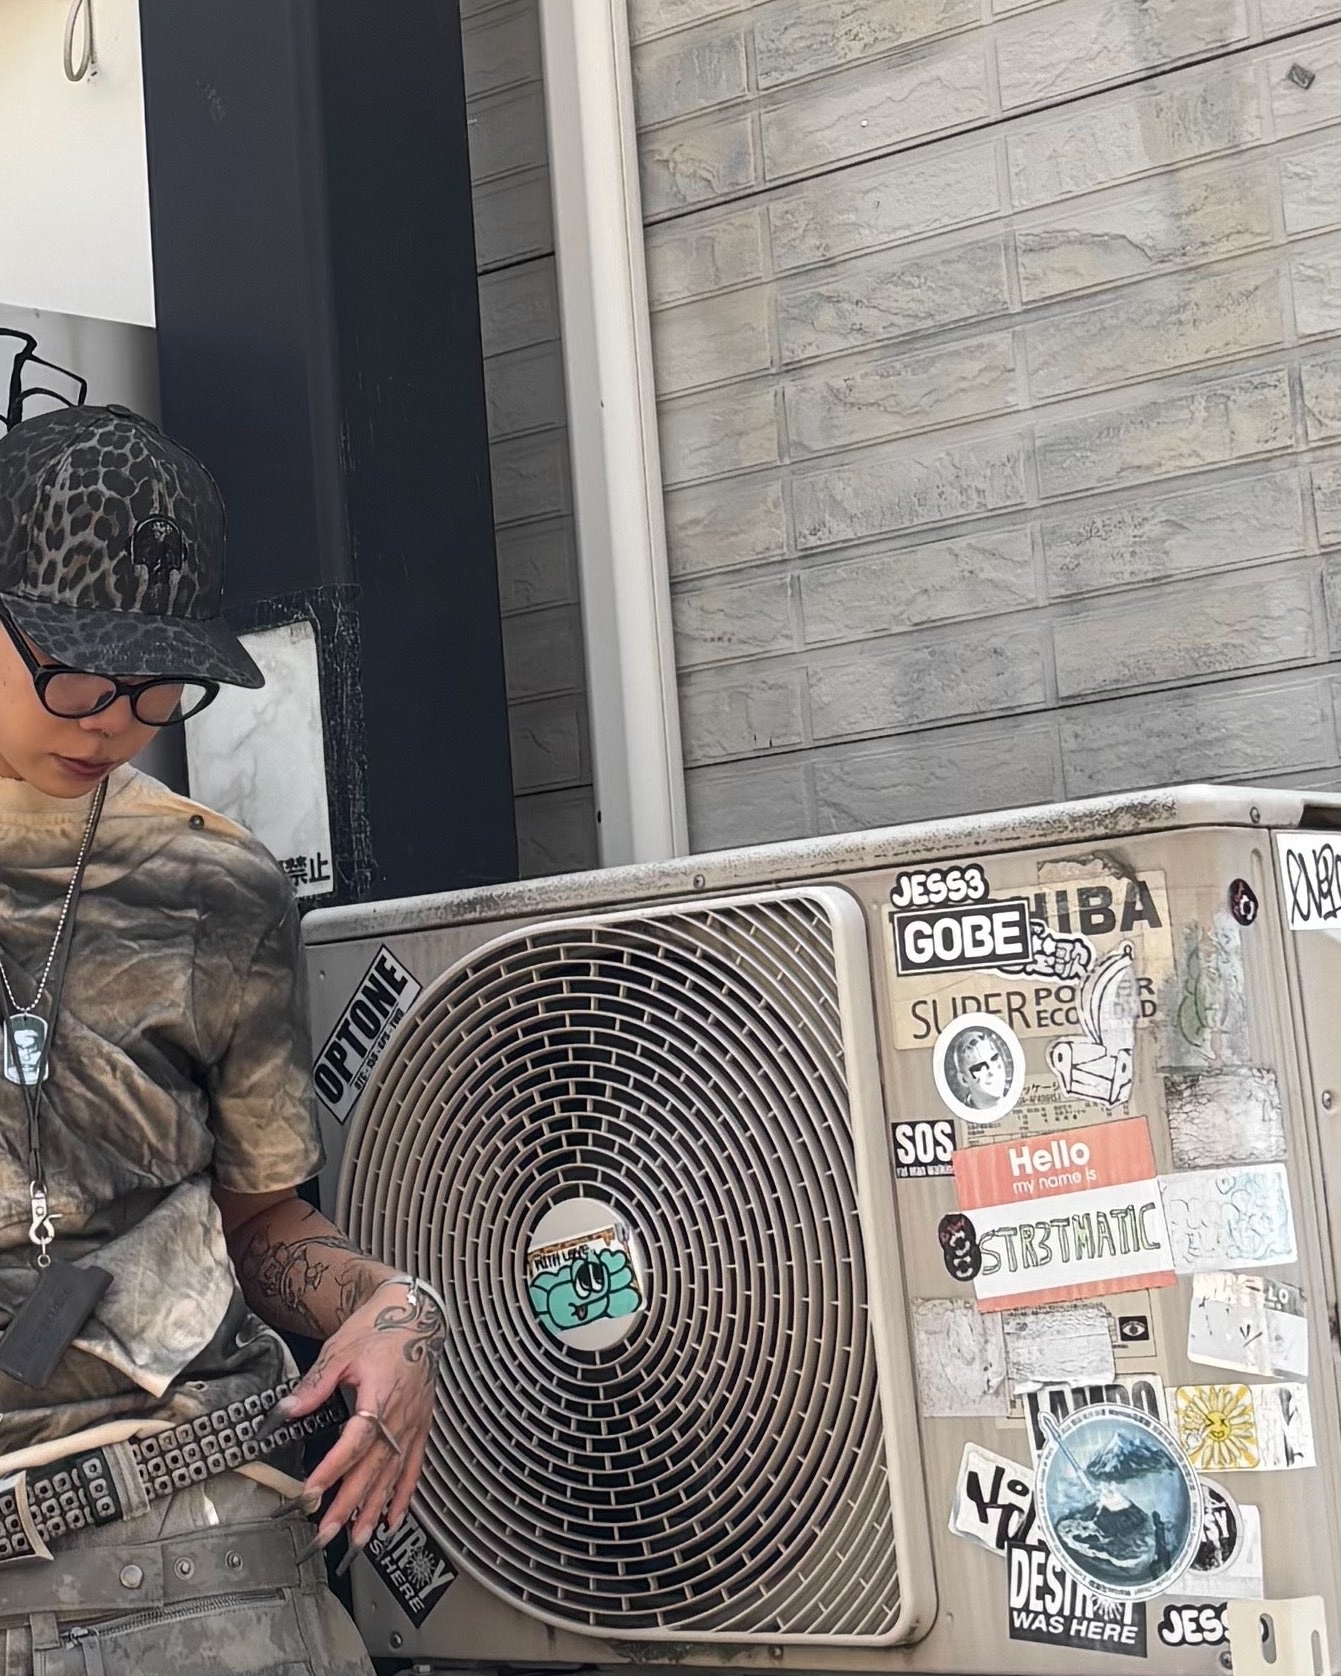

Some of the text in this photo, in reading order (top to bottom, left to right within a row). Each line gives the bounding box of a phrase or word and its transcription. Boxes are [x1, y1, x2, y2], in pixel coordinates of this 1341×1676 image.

[279, 852, 330, 885] 禁止
[892, 869, 985, 907] JESS3
[1029, 880, 1163, 936] HIBA
[904, 911, 1023, 963] GOBE
[1034, 977, 1155, 1007] POR
[314, 954, 408, 1104] OPTONE
[895, 1122, 953, 1165] SOS
[1009, 1140, 1090, 1176] Hello
[1013, 1167, 1097, 1195] my name is
[381, 1556, 425, 1613] HERE
[1012, 1611, 1138, 1644] WAS HERE
[1162, 1605, 1231, 1643] JES
